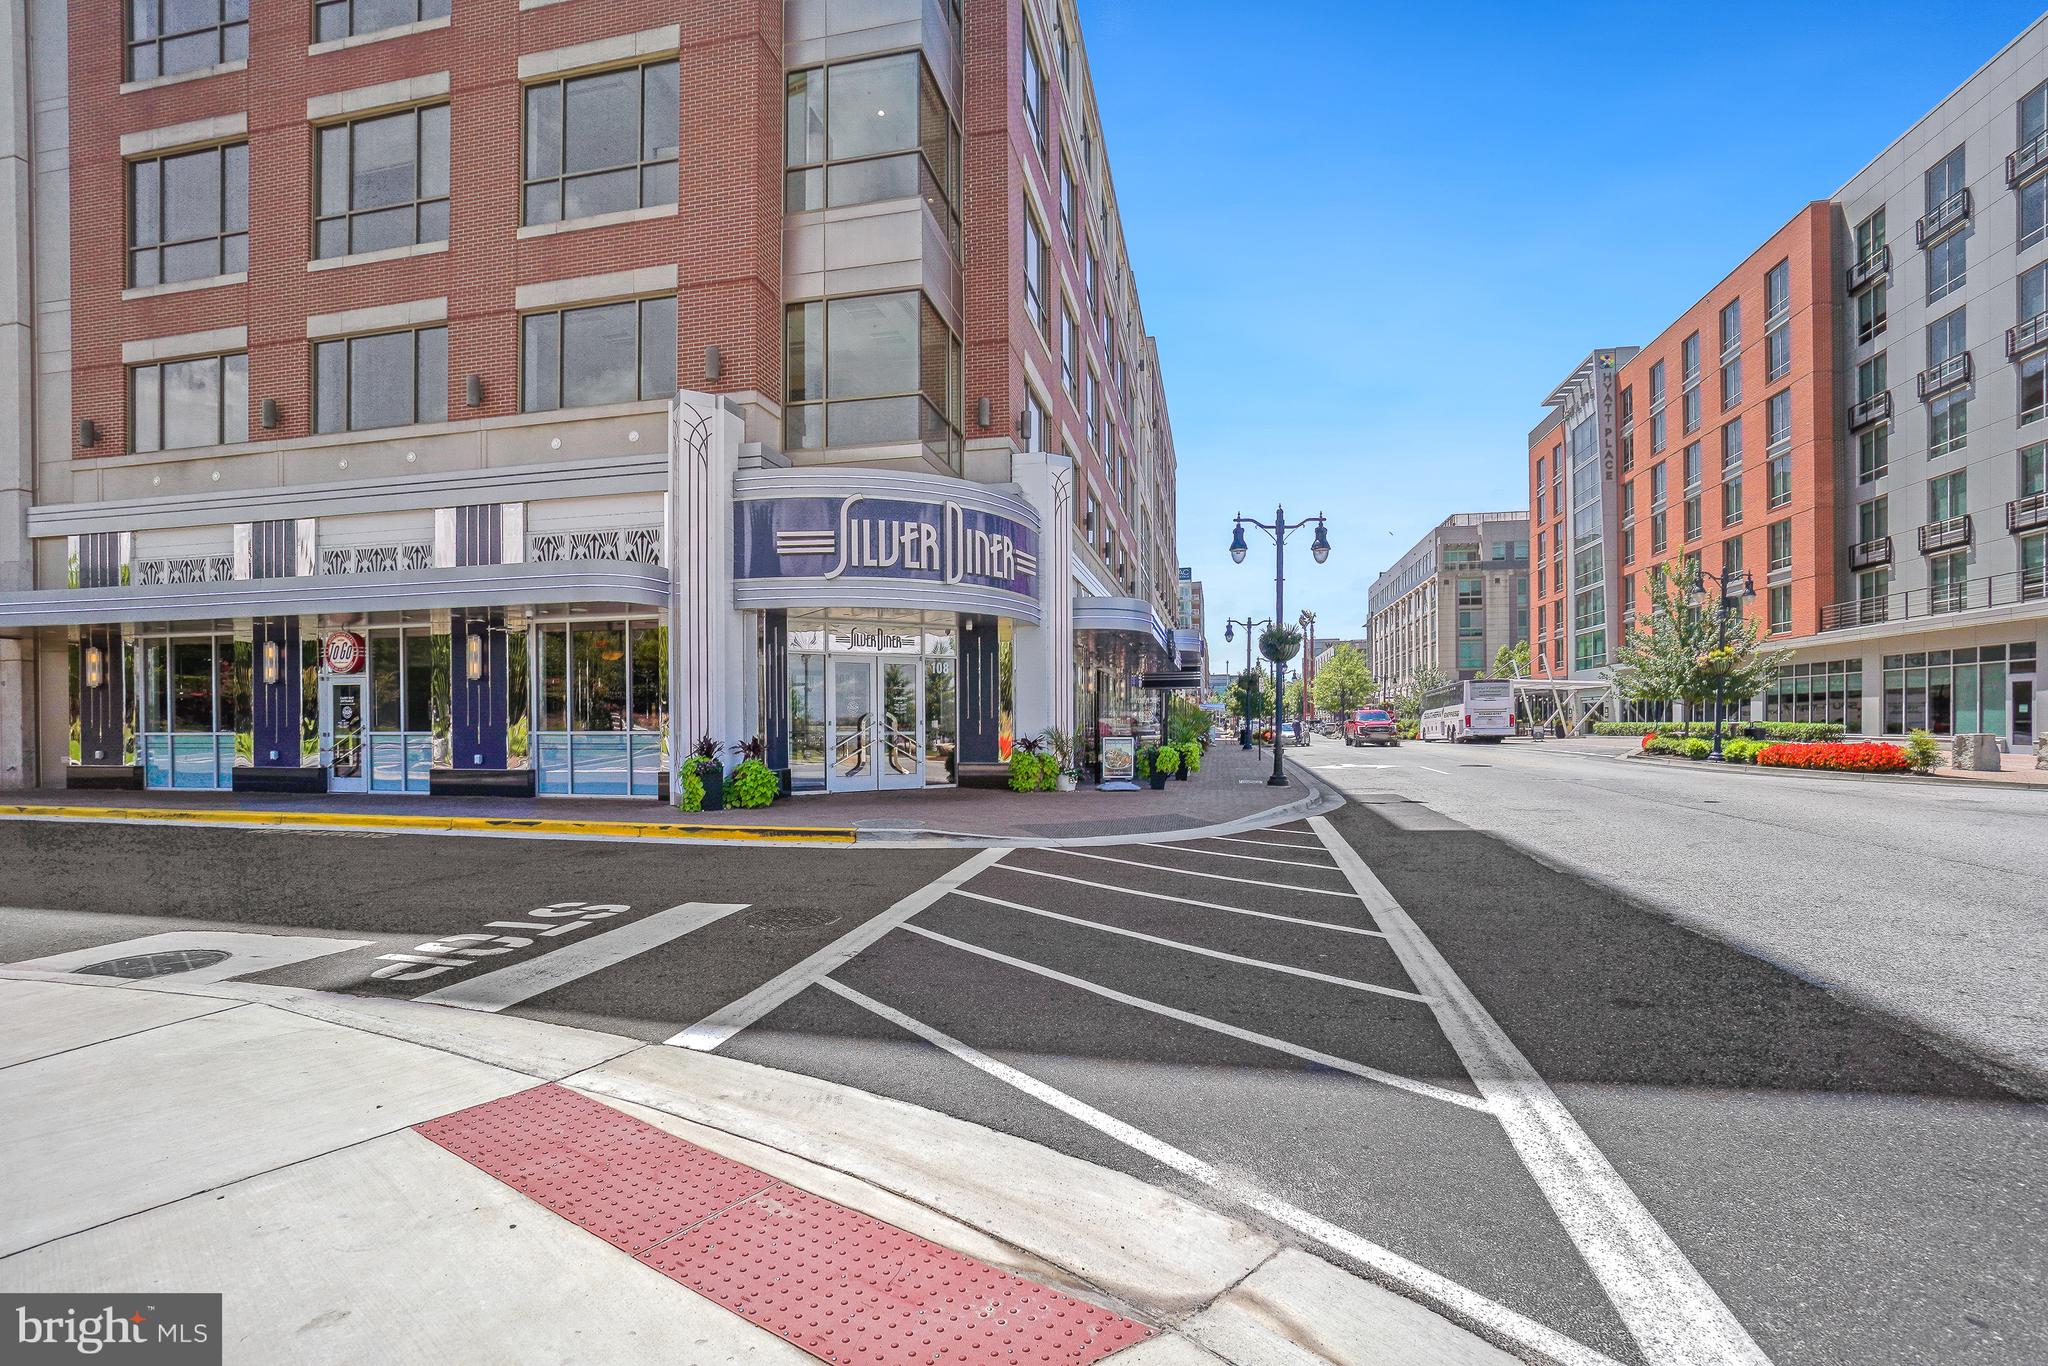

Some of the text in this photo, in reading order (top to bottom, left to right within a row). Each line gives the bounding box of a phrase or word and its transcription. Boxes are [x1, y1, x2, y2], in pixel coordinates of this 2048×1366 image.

[1603, 372, 1614, 481] HYATT PLACE
[823, 492, 1015, 585] SILVER DINER
[847, 627, 902, 651] SILVER DINER
[931, 662, 950, 674] 108
[370, 902, 631, 981] STOP
